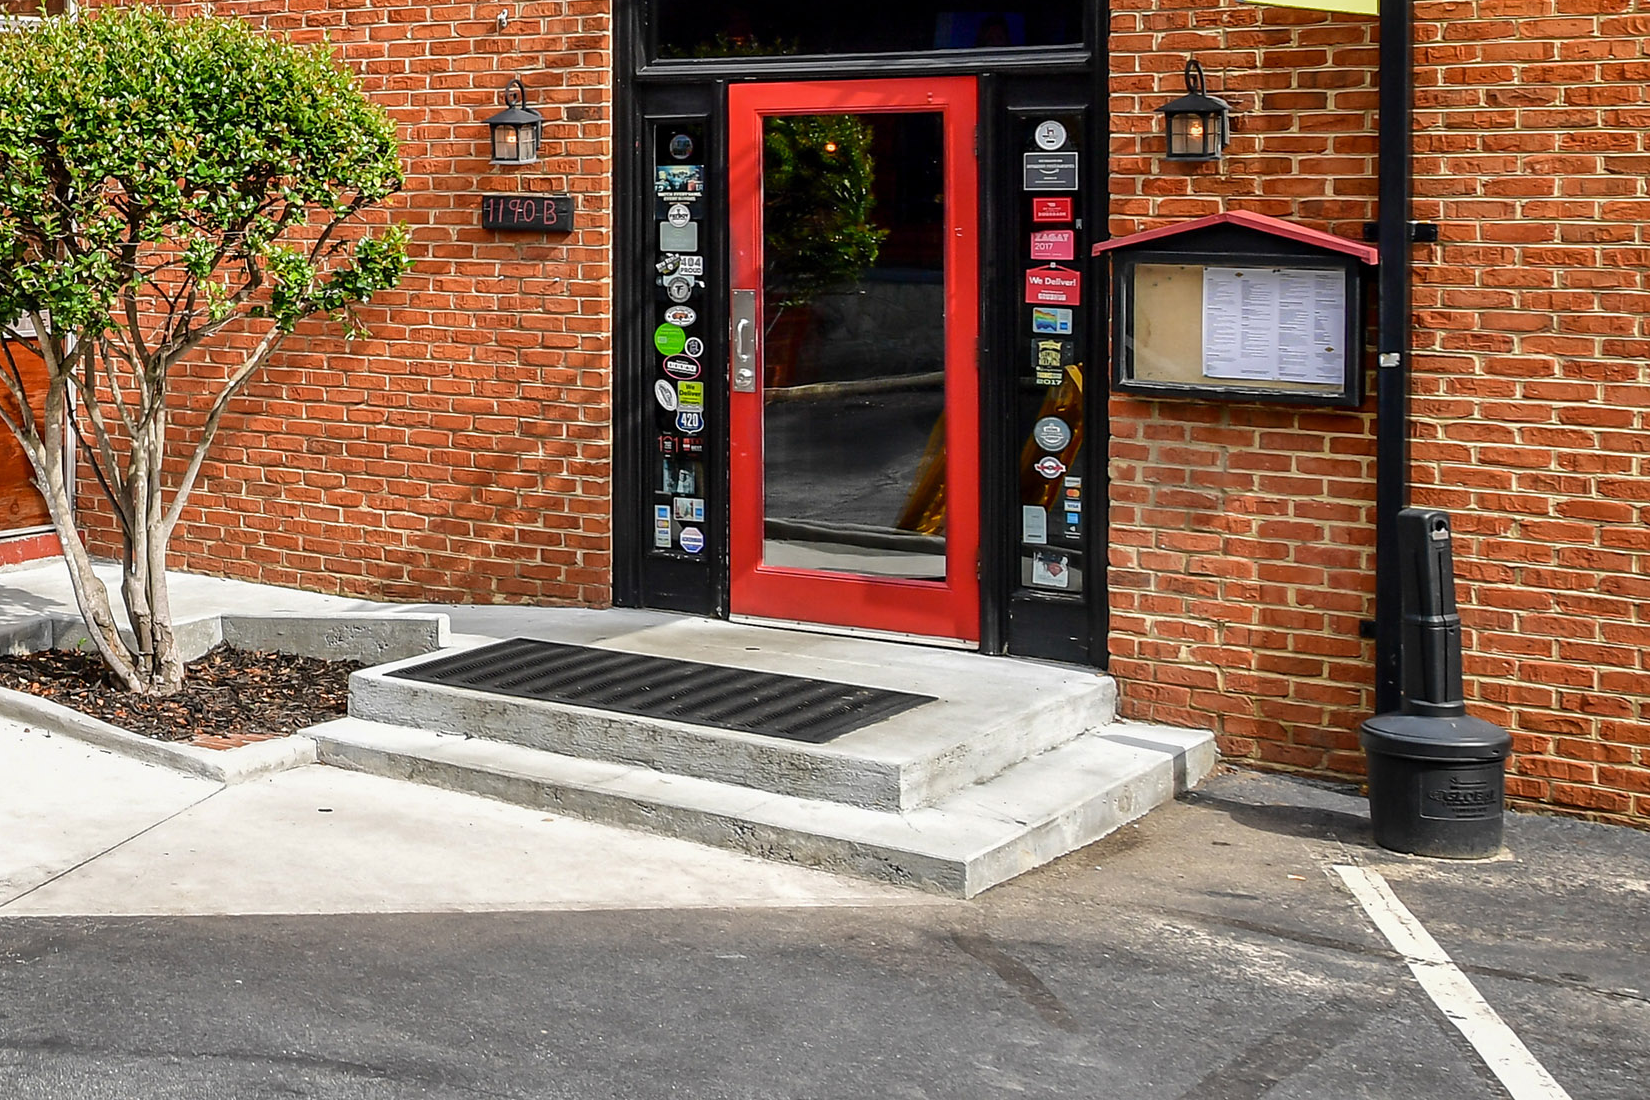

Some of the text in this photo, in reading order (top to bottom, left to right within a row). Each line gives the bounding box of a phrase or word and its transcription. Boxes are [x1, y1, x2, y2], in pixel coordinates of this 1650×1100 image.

[488, 198, 557, 225] 1190 B
[1034, 233, 1069, 242] ZAGAT
[680, 257, 701, 267] 404
[1029, 276, 1076, 286] We Deliver!
[681, 413, 699, 427] 420
